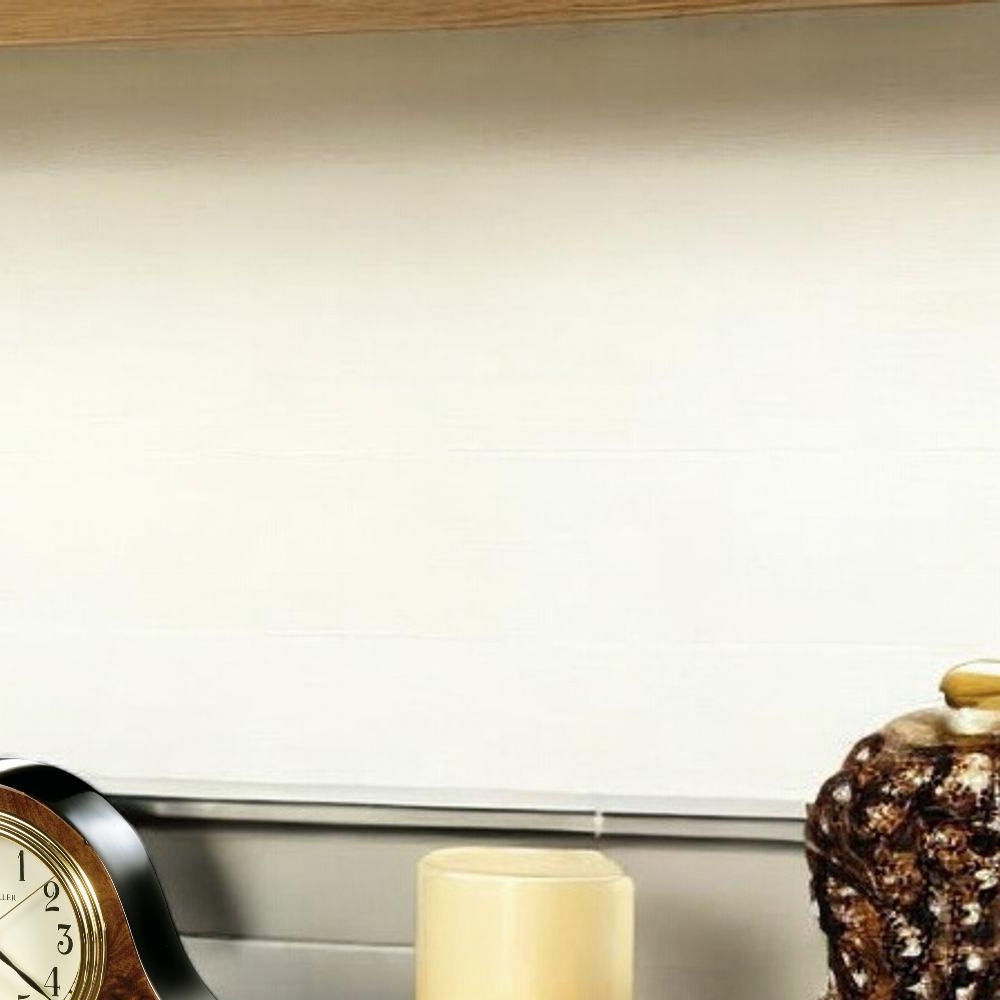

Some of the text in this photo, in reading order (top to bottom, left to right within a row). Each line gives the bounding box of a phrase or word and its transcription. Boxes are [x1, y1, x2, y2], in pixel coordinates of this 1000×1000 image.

[16, 849, 26, 882] 1
[43, 880, 60, 912] 2
[57, 923, 74, 956] 3
[43, 966, 60, 997] 4
